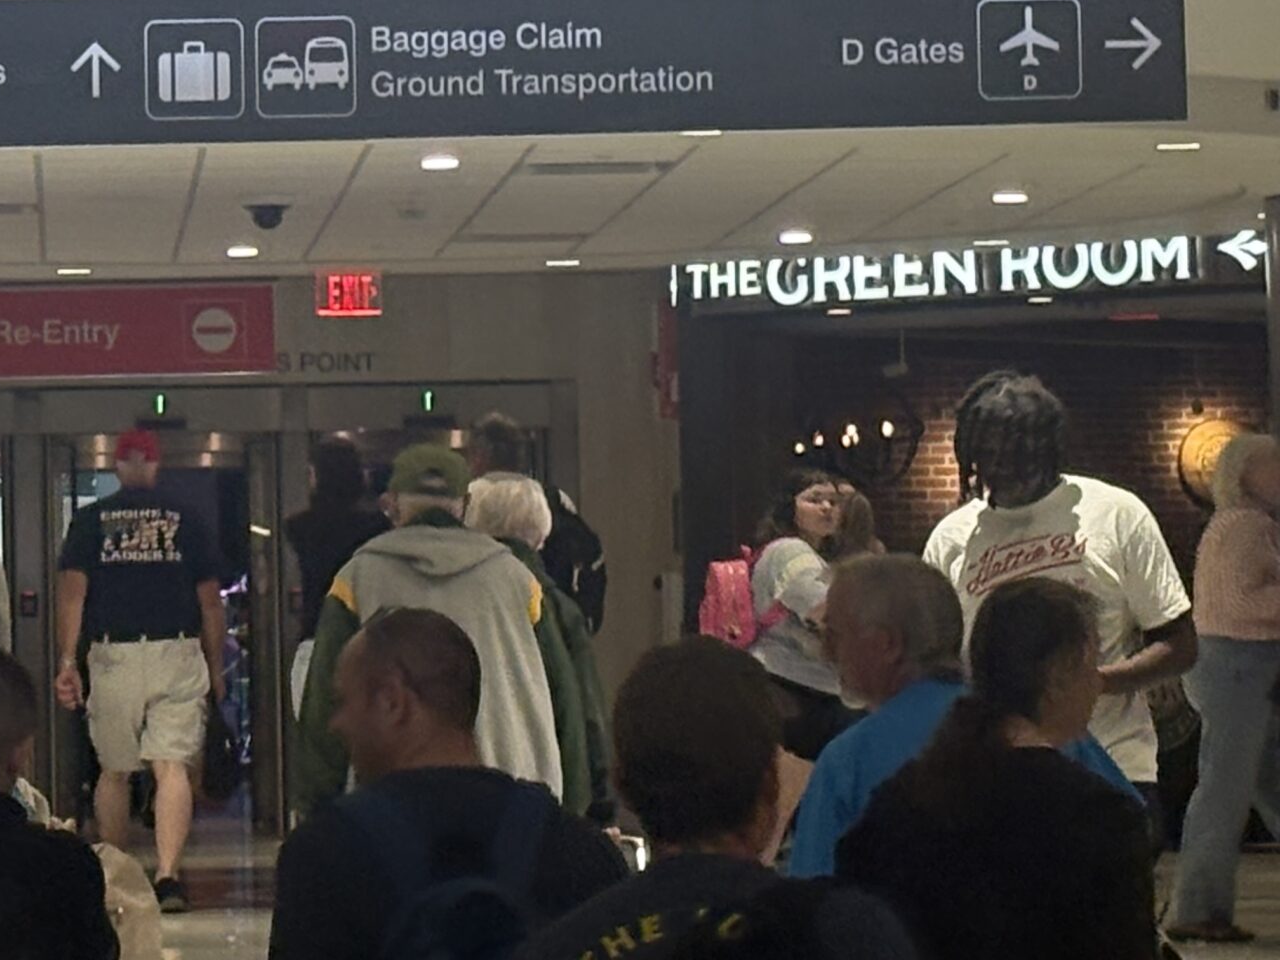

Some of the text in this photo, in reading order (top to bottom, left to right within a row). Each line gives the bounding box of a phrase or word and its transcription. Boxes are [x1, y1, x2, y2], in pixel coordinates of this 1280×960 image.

[370, 21, 602, 59] Baggage Claim
[842, 37, 965, 66] D Gates
[370, 64, 713, 101] Ground Transportation
[1023, 74, 1038, 91] D
[685, 235, 1191, 306] THE GREEN ROOM
[328, 274, 373, 310] EXIT
[299, 351, 377, 375] POINT
[100, 549, 163, 563] LADDER
